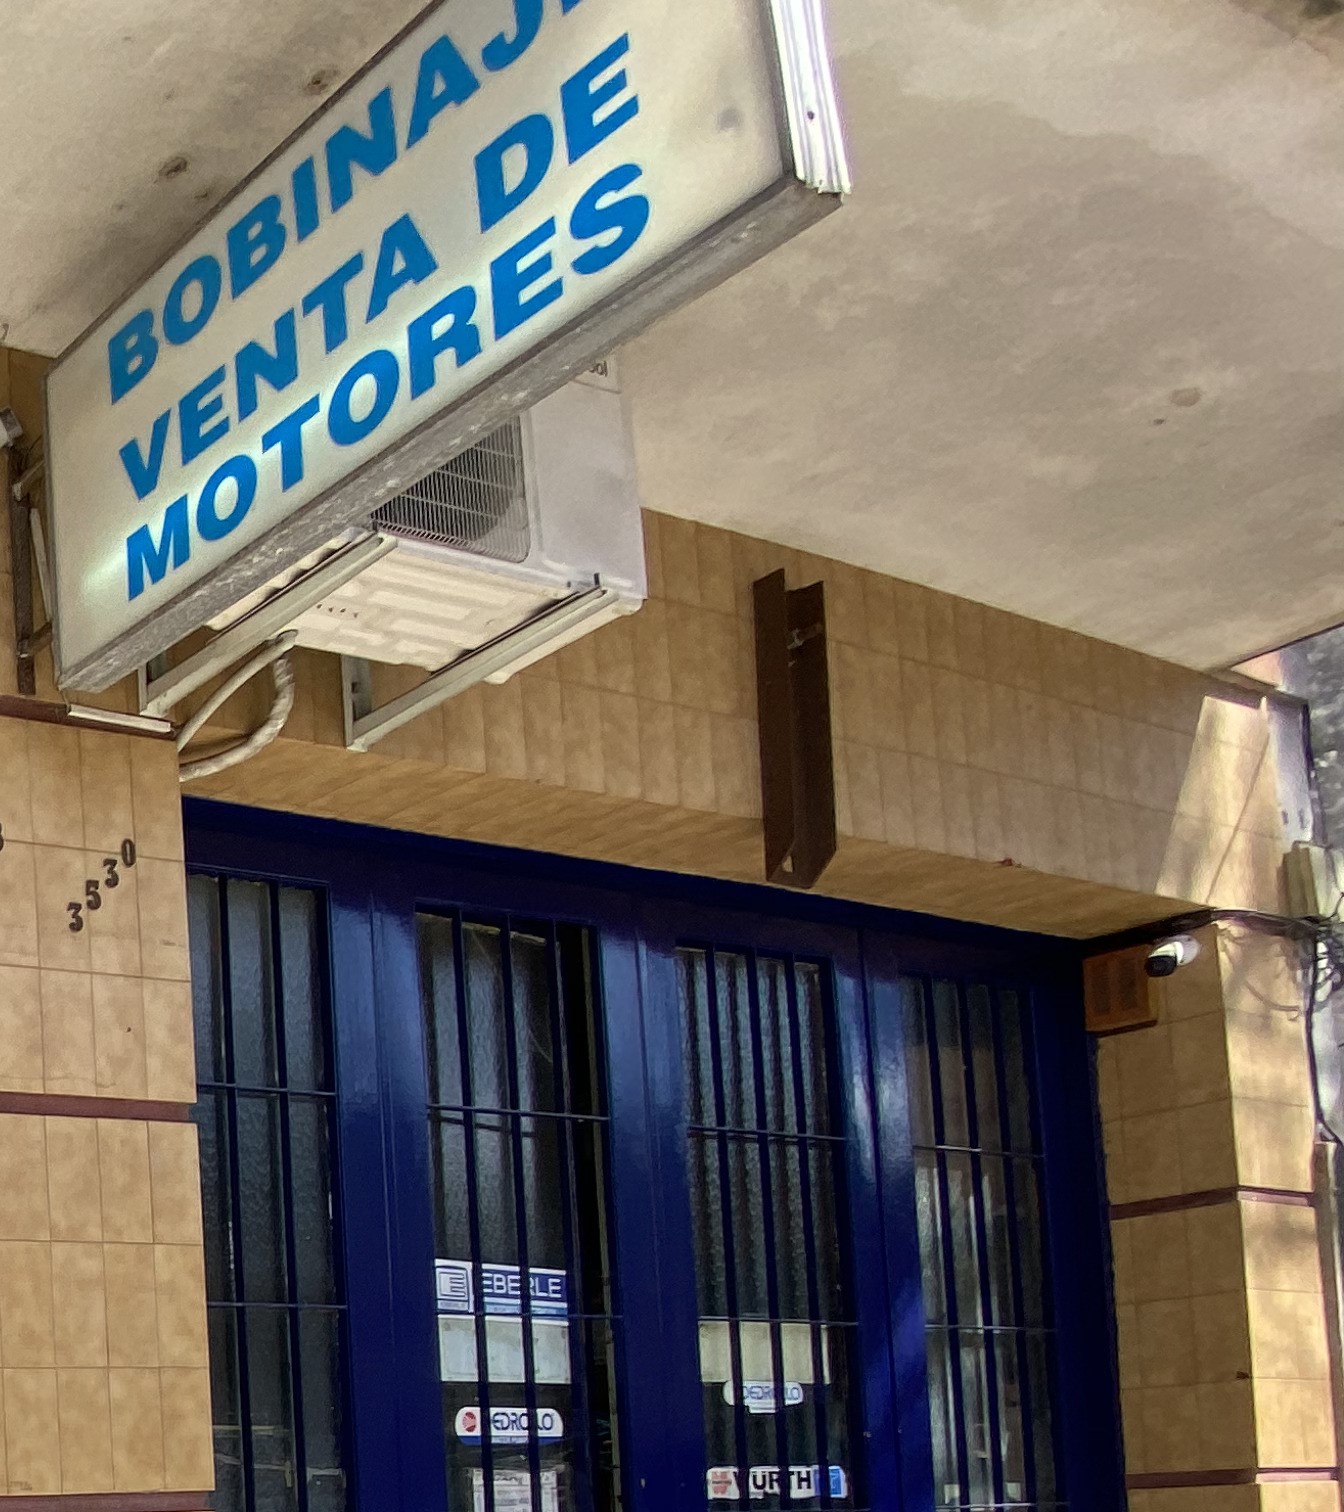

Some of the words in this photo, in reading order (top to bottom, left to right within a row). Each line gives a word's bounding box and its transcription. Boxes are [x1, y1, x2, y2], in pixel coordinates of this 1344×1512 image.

[107, 0, 582, 404] BOBINAJ
[118, 215, 438, 501] VENTA
[474, 33, 641, 234] DE
[126, 162, 651, 601] MOTORES
[66, 838, 137, 932] 3530
